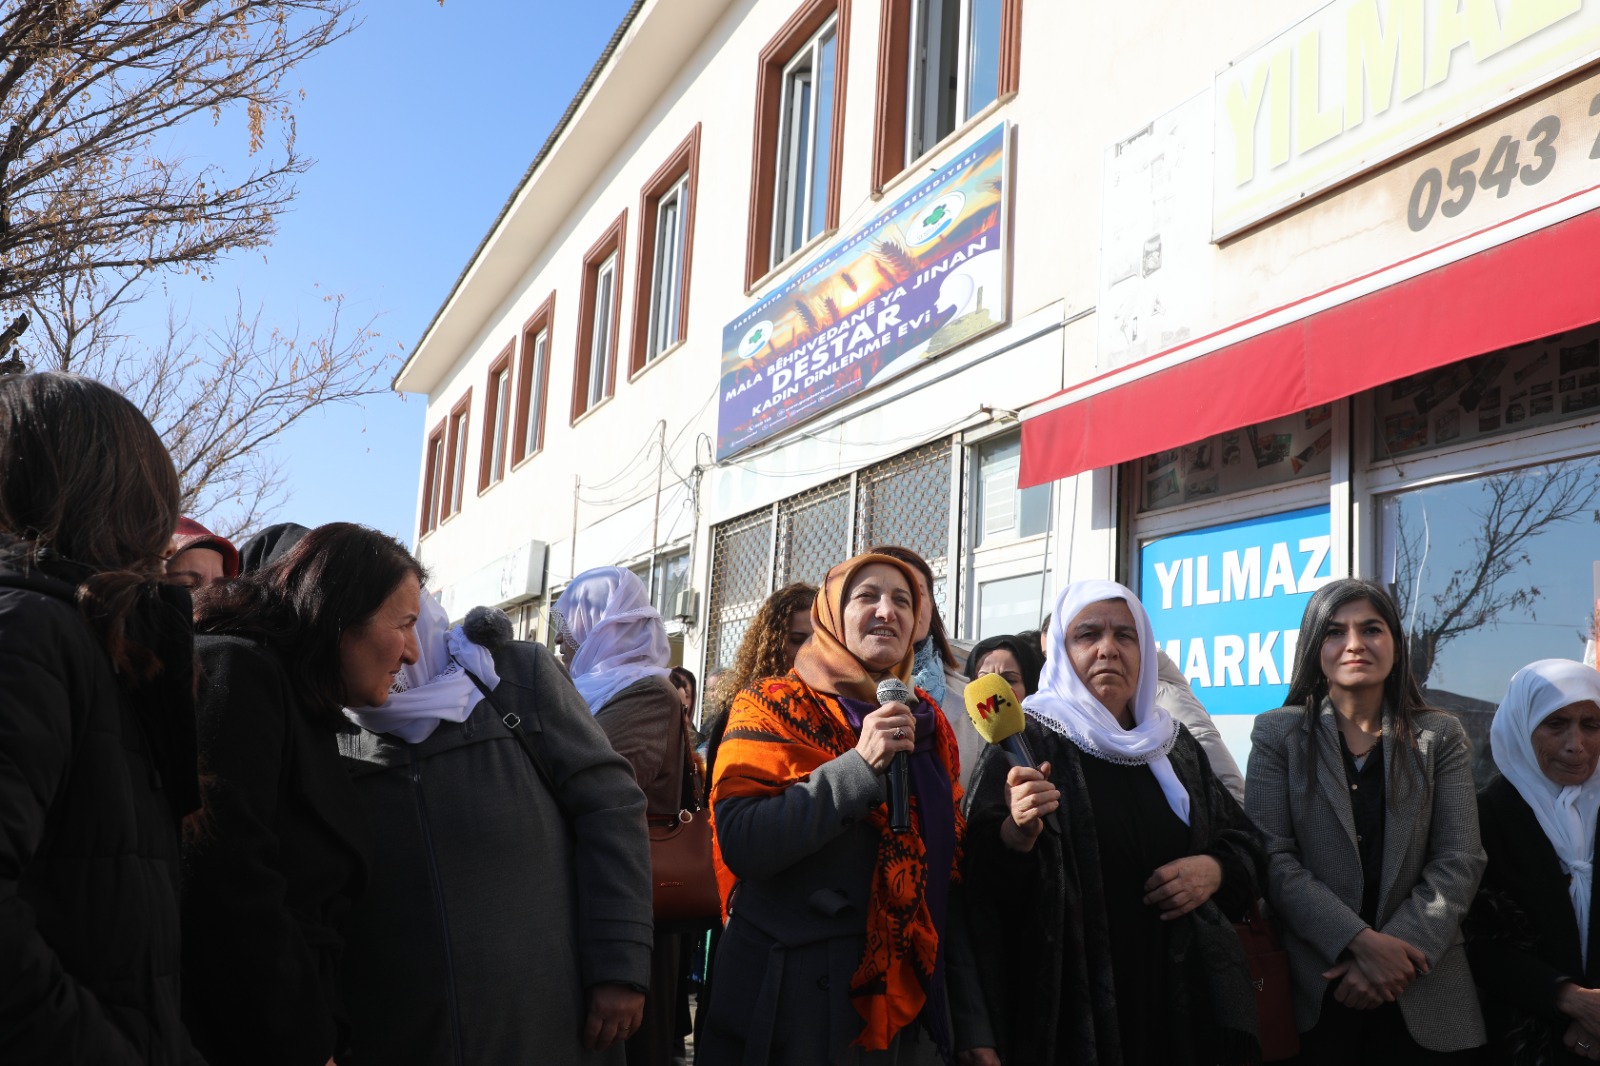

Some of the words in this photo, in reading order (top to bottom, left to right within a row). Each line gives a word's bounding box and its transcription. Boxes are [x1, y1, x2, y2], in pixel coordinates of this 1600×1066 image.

[1224, 0, 1582, 187] YILMA
[1407, 114, 1562, 233] 0543
[725, 372, 763, 402] MALA
[767, 300, 876, 377] BÊHNVEDANÊ
[880, 287, 907, 312] YA
[912, 236, 987, 290] JINAN
[771, 303, 902, 394] DESTAR
[752, 382, 799, 417] KADIN
[1153, 534, 1332, 610] YILMAZ
